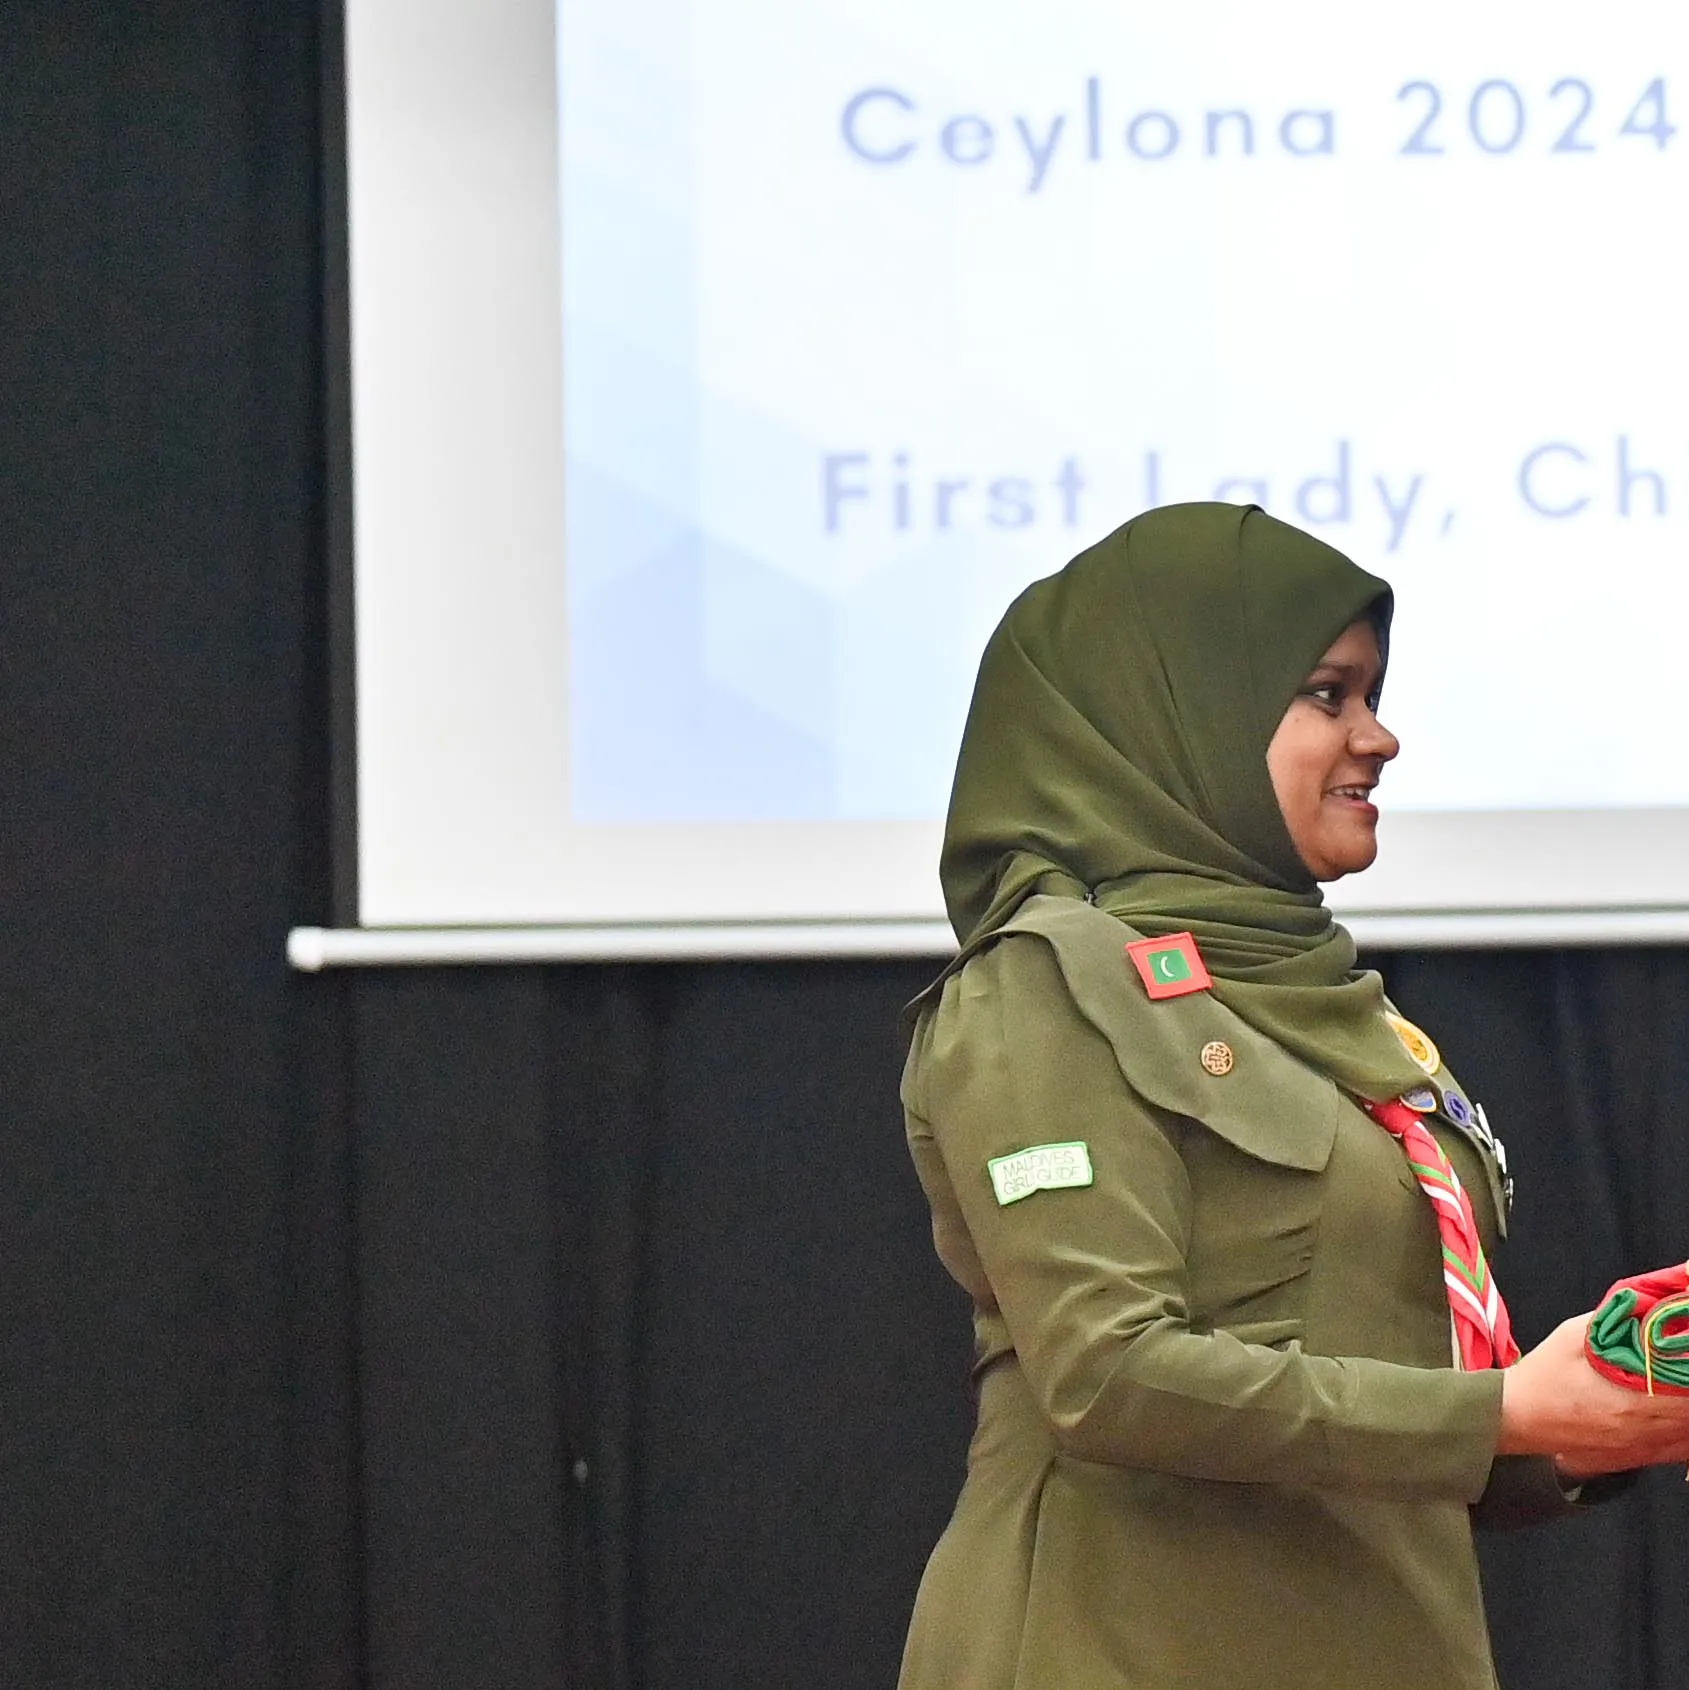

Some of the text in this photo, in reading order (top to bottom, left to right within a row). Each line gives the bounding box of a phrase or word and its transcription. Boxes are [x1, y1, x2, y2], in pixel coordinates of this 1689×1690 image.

[837, 73, 1339, 197] Ceylona
[815, 448, 1087, 539] First
[1003, 1150, 1075, 1180] MALDIVES
